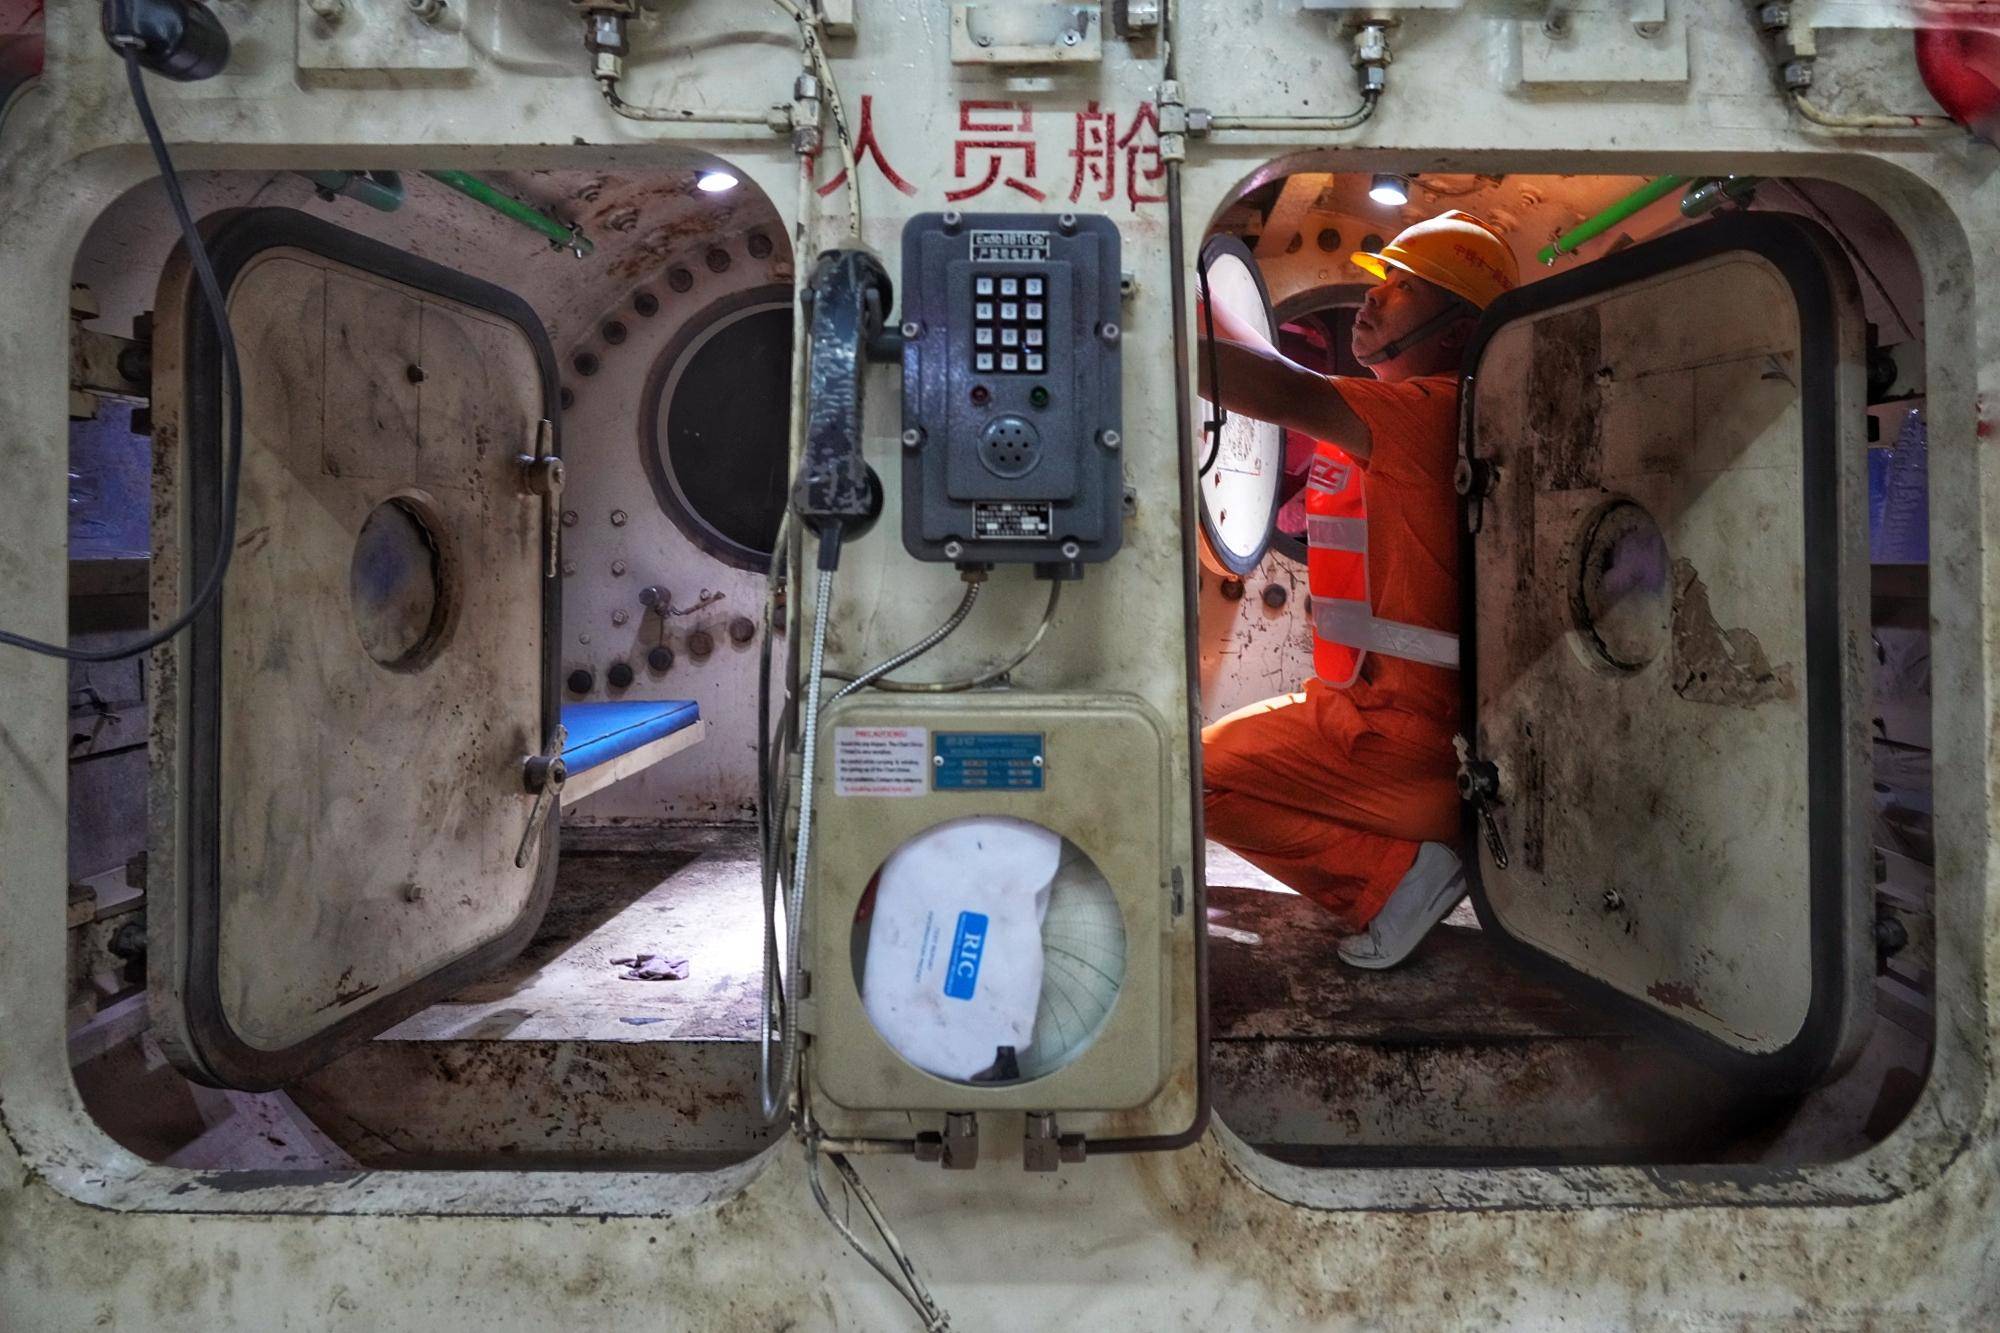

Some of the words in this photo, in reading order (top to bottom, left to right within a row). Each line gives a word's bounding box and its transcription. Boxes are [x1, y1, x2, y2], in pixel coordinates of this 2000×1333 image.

[816, 95, 1168, 207] 人员舱
[957, 932, 982, 979] RIC
